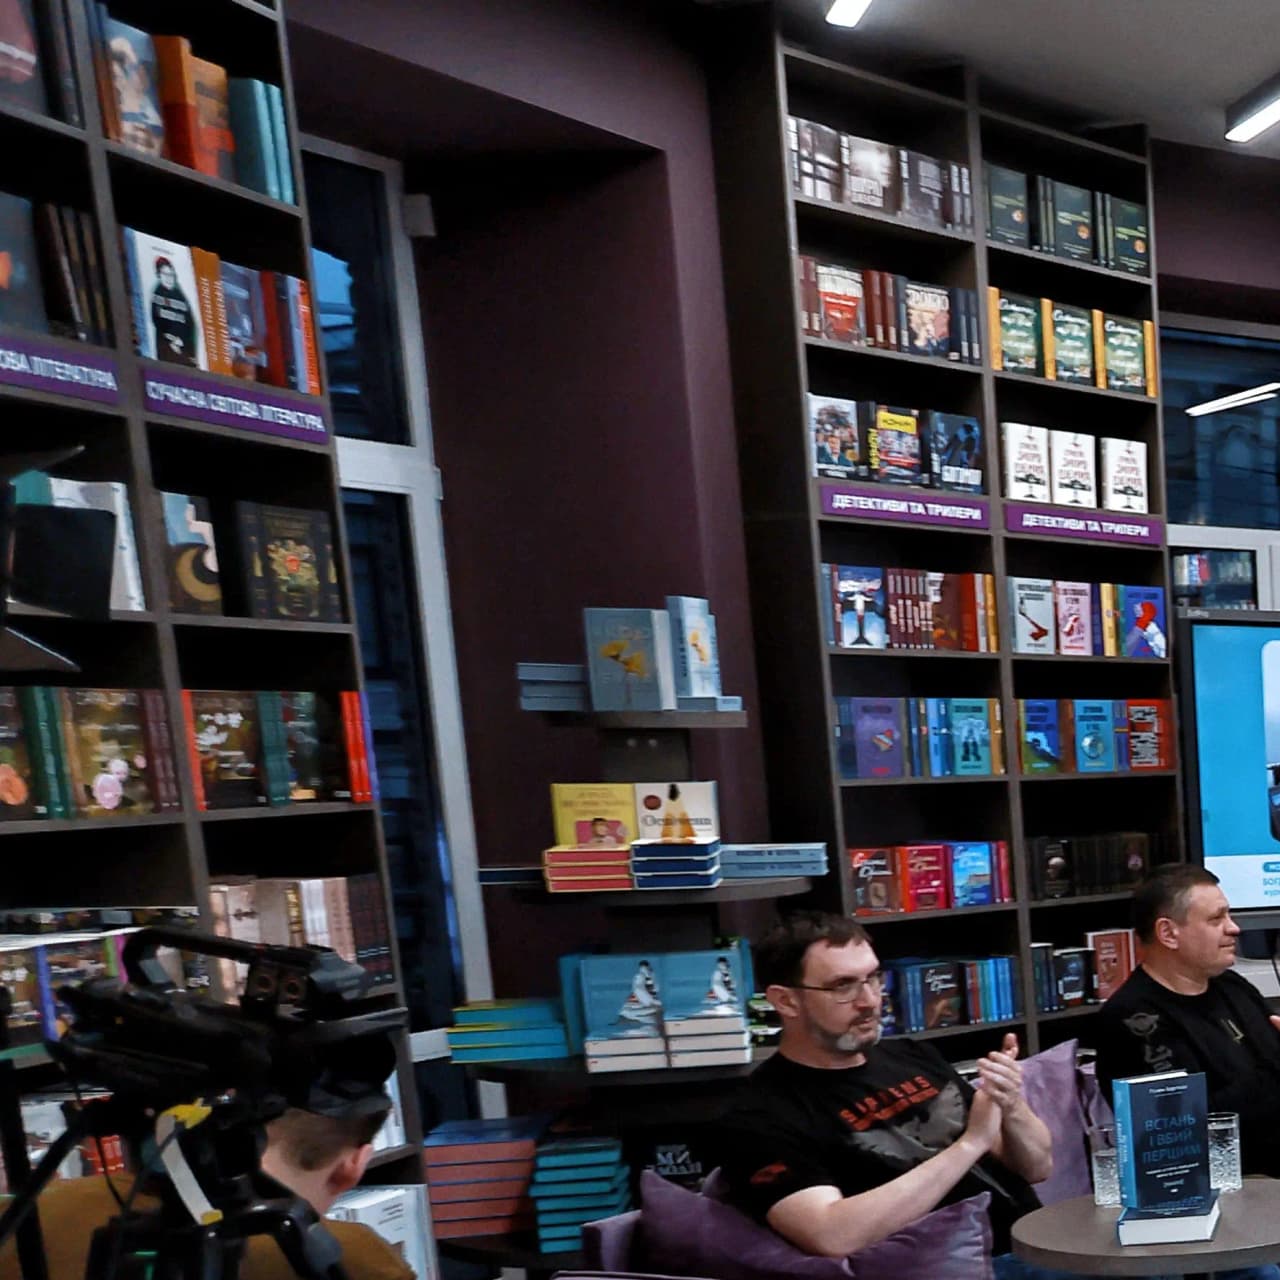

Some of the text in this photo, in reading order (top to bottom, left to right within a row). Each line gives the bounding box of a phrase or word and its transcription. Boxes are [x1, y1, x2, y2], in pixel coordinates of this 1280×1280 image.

[832, 493, 982, 520] ДЕТЕКТИВИ ТА ТРИЛЕРИ
[1022, 512, 1150, 538] ДЕТЕКТИВИ ТА ТРИЛЕРИ
[1145, 1114, 1196, 1131] ВСТАНЬ
[1157, 1127, 1193, 1145] ВБИЙ
[1142, 1146, 1201, 1164] ПЕРШИМ
